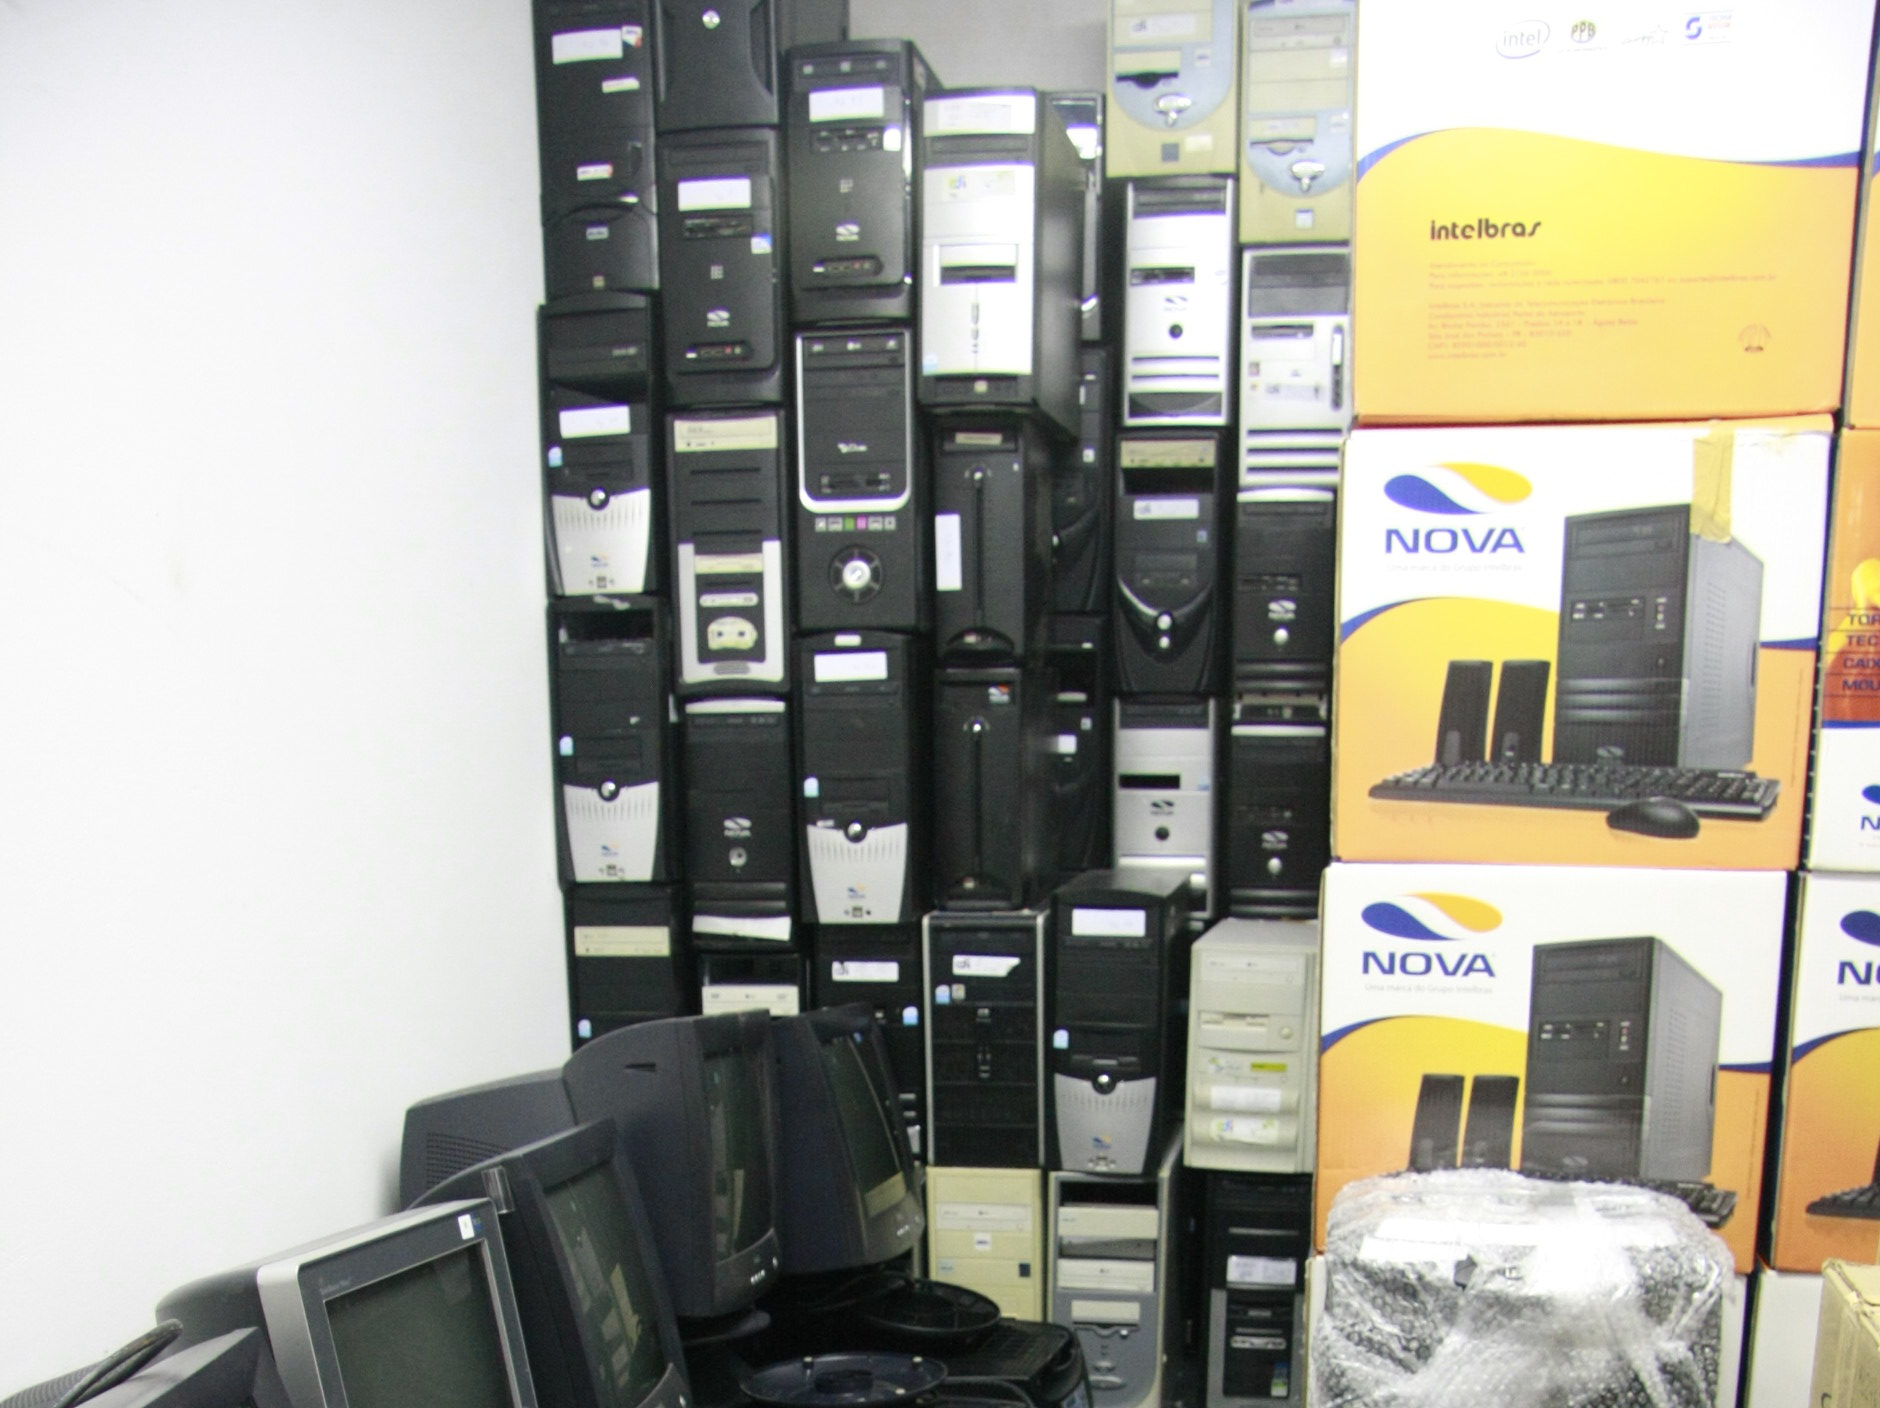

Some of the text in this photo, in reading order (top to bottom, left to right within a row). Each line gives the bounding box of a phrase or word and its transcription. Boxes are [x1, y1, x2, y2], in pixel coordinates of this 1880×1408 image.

[1503, 29, 1541, 47] intel
[1430, 218, 1541, 240] intelbras
[1385, 526, 1525, 553] NOVA
[1362, 951, 1497, 978] NOVA
